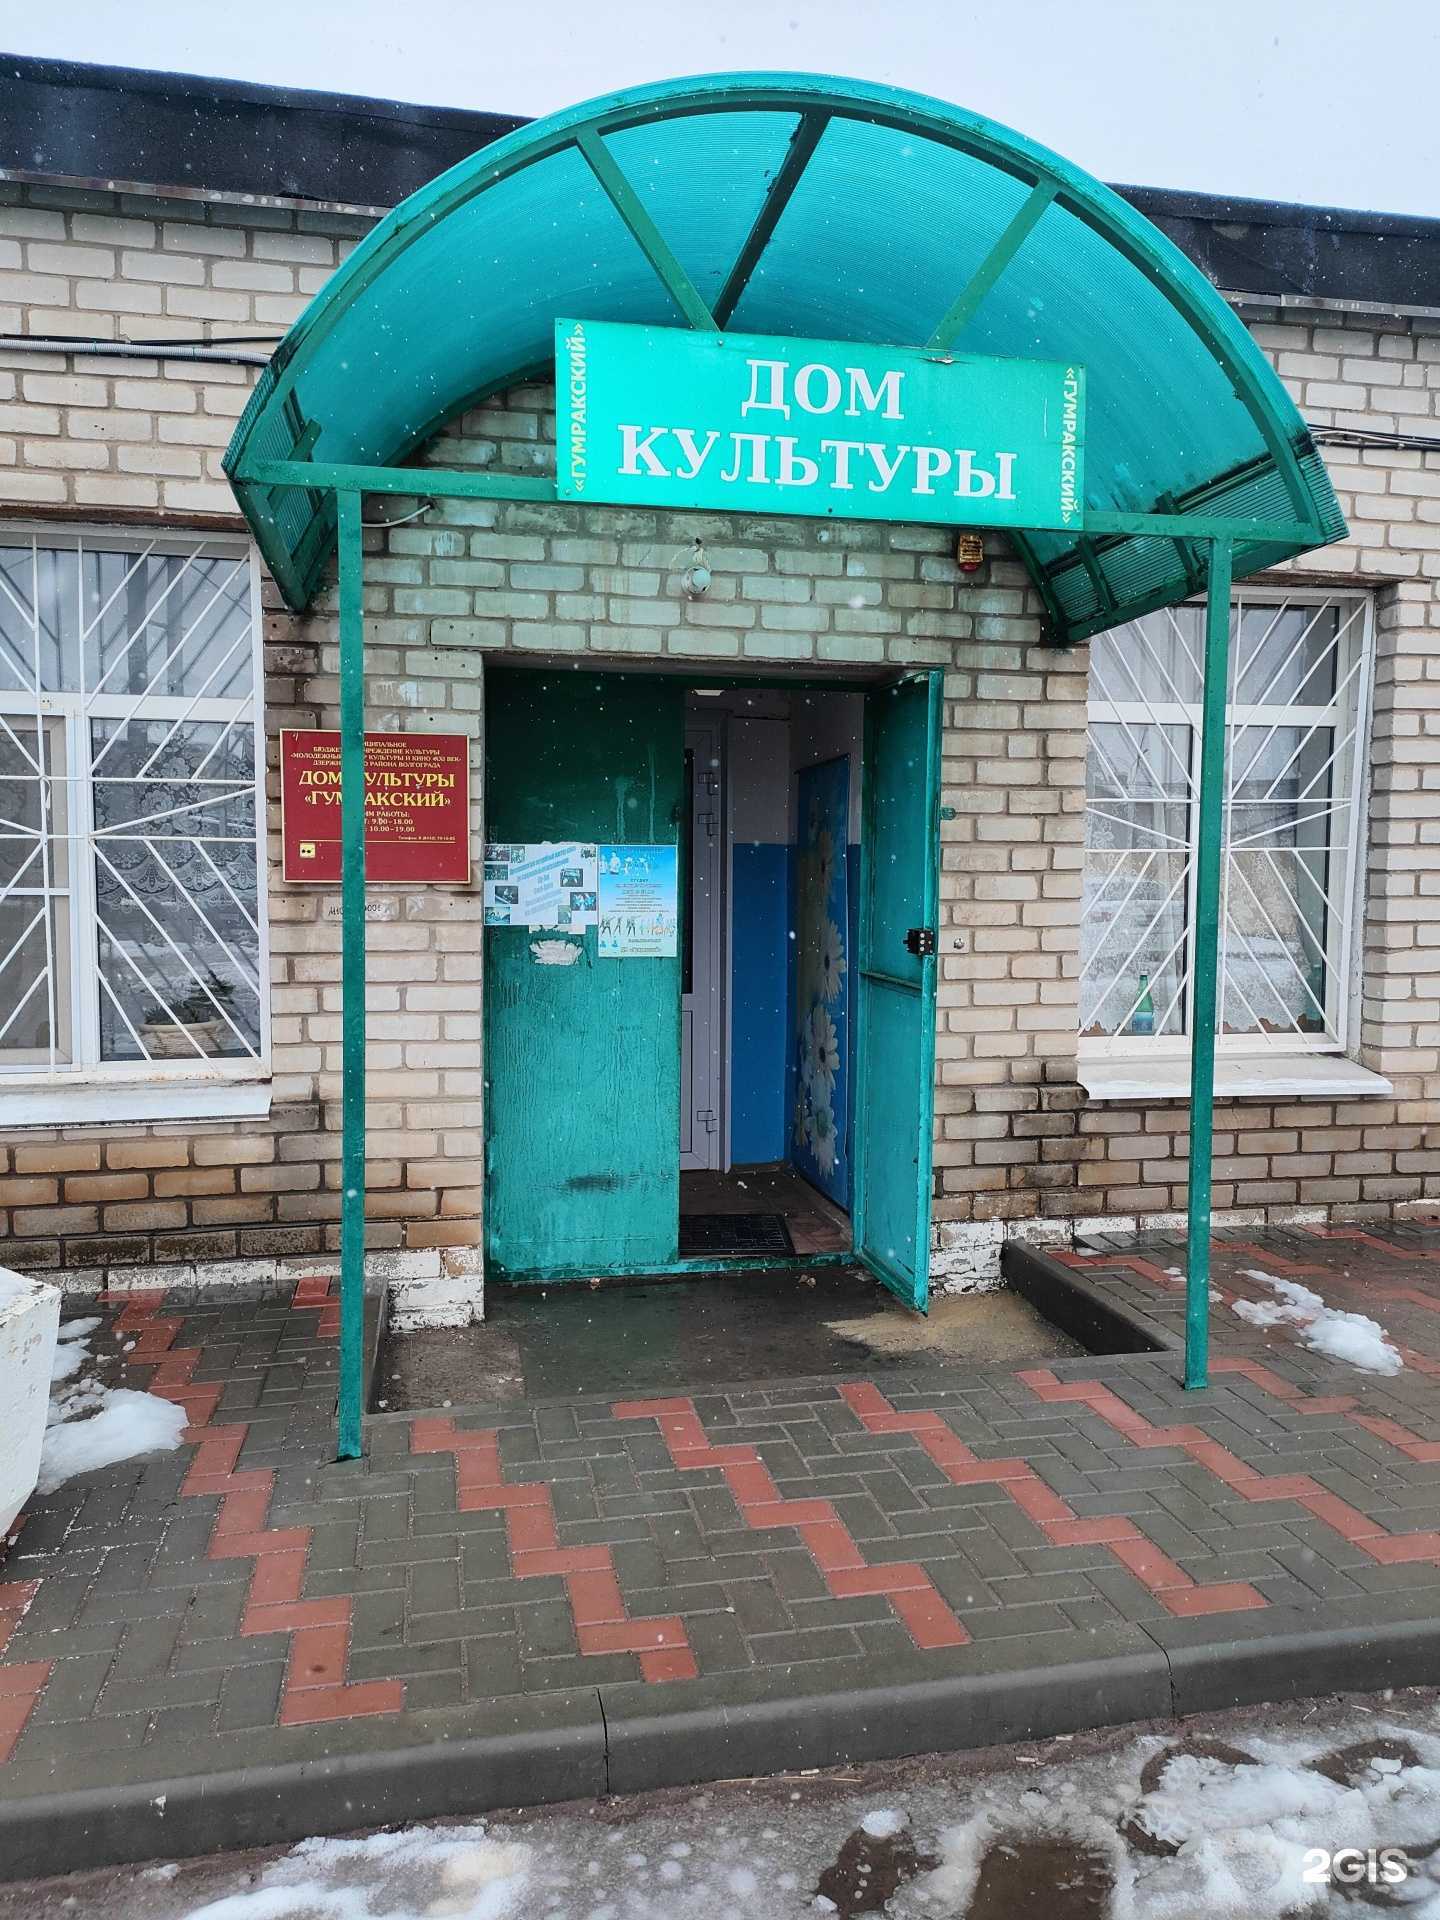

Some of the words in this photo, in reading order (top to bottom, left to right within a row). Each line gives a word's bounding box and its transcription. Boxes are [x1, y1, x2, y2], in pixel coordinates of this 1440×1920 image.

[566, 323, 587, 492] «ГУМРАКСКИЙ»
[741, 359, 906, 421] ДОМ
[616, 424, 1018, 500] КУЛЬТУРЫ
[1060, 367, 1079, 524] «ГУМРАКСКИЙ»
[299, 770, 343, 786] ДОМ
[363, 772, 455, 788] УЛЬТУРЫ
[398, 761, 441, 769] ВОЛГОГРАДА
[304, 791, 451, 807] «ГУАКСКИЙ»
